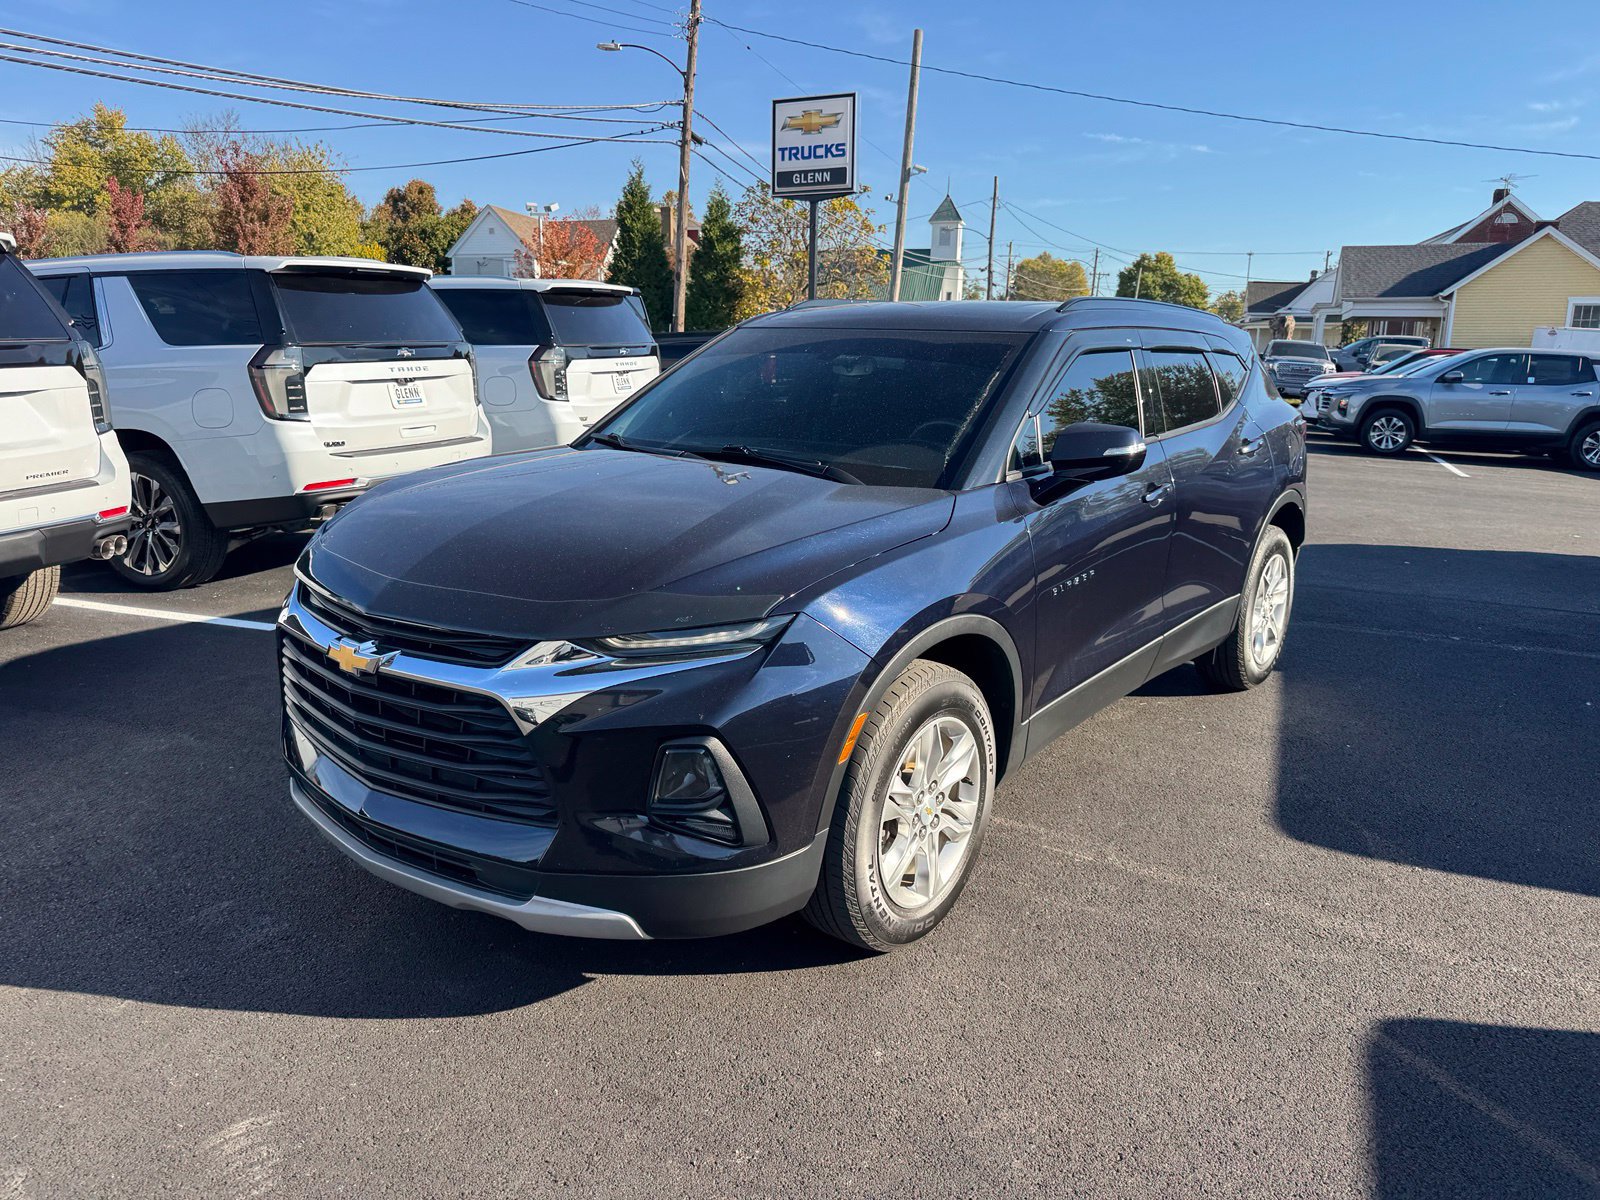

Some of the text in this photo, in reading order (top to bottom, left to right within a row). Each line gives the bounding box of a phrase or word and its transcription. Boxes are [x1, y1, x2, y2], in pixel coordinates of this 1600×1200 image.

[778, 143, 846, 162] TRUCKS
[792, 171, 831, 184] GLENN
[388, 365, 430, 373] TAHOE
[395, 387, 421, 399] GLENN
[25, 469, 69, 480] PREMIER
